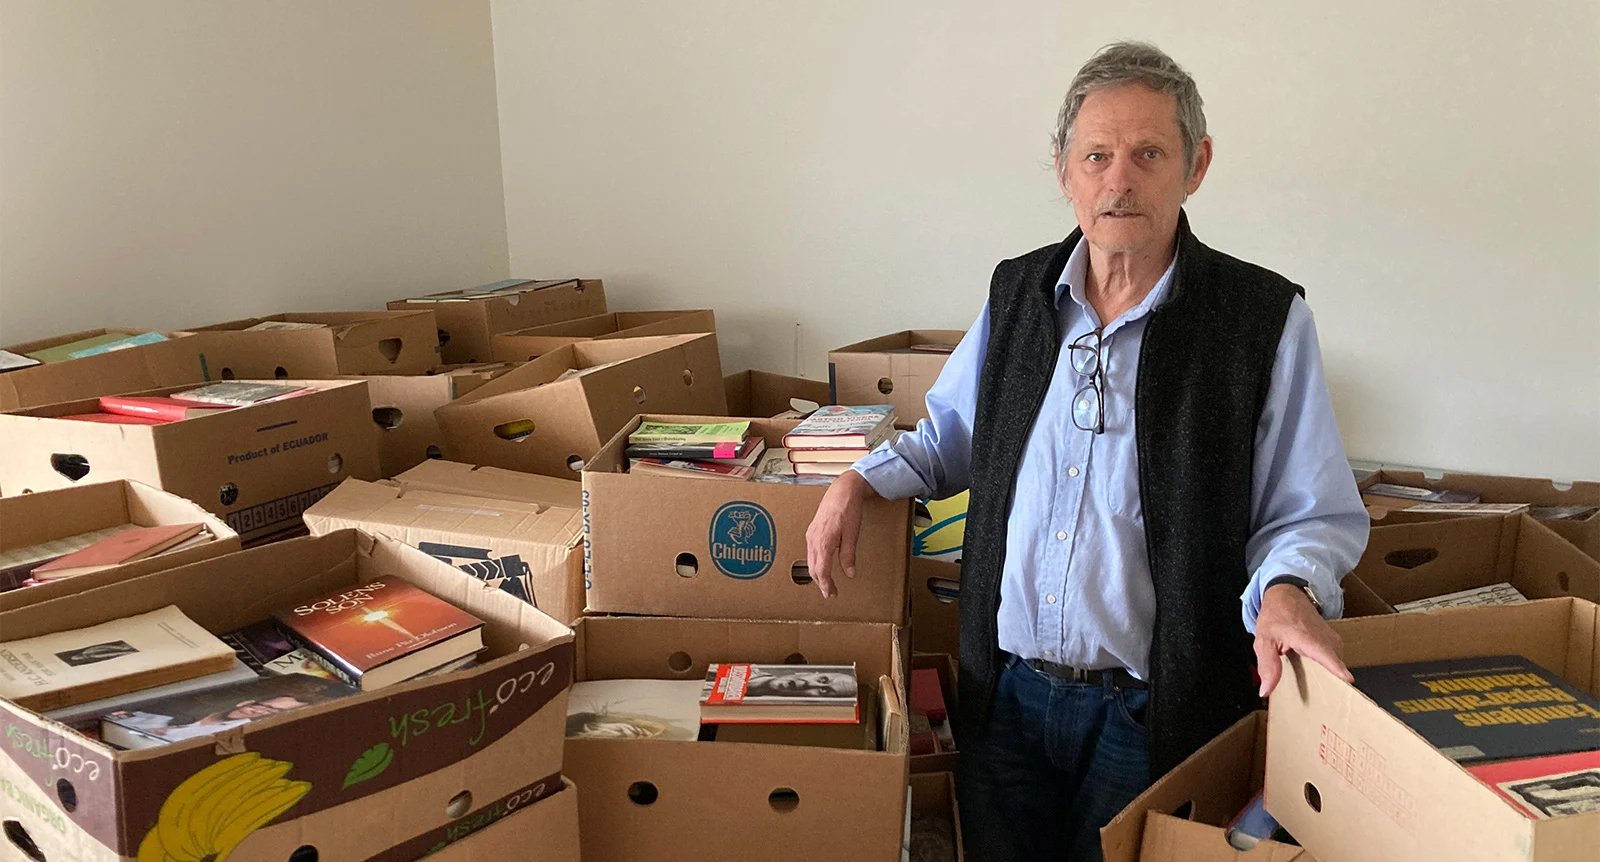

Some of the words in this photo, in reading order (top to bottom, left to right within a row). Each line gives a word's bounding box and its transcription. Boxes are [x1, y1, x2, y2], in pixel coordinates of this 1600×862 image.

[228, 447, 268, 465] Product
[270, 444, 280, 454] of
[283, 432, 329, 451] ECUADOR
[711, 542, 773, 564] Chiquita
[293, 581, 386, 617] SOLENS
[324, 593, 373, 616] SON
[1419, 673, 1551, 695] Handbok
[1392, 687, 1576, 713] Reparations
[1454, 703, 1600, 728] Familjens
